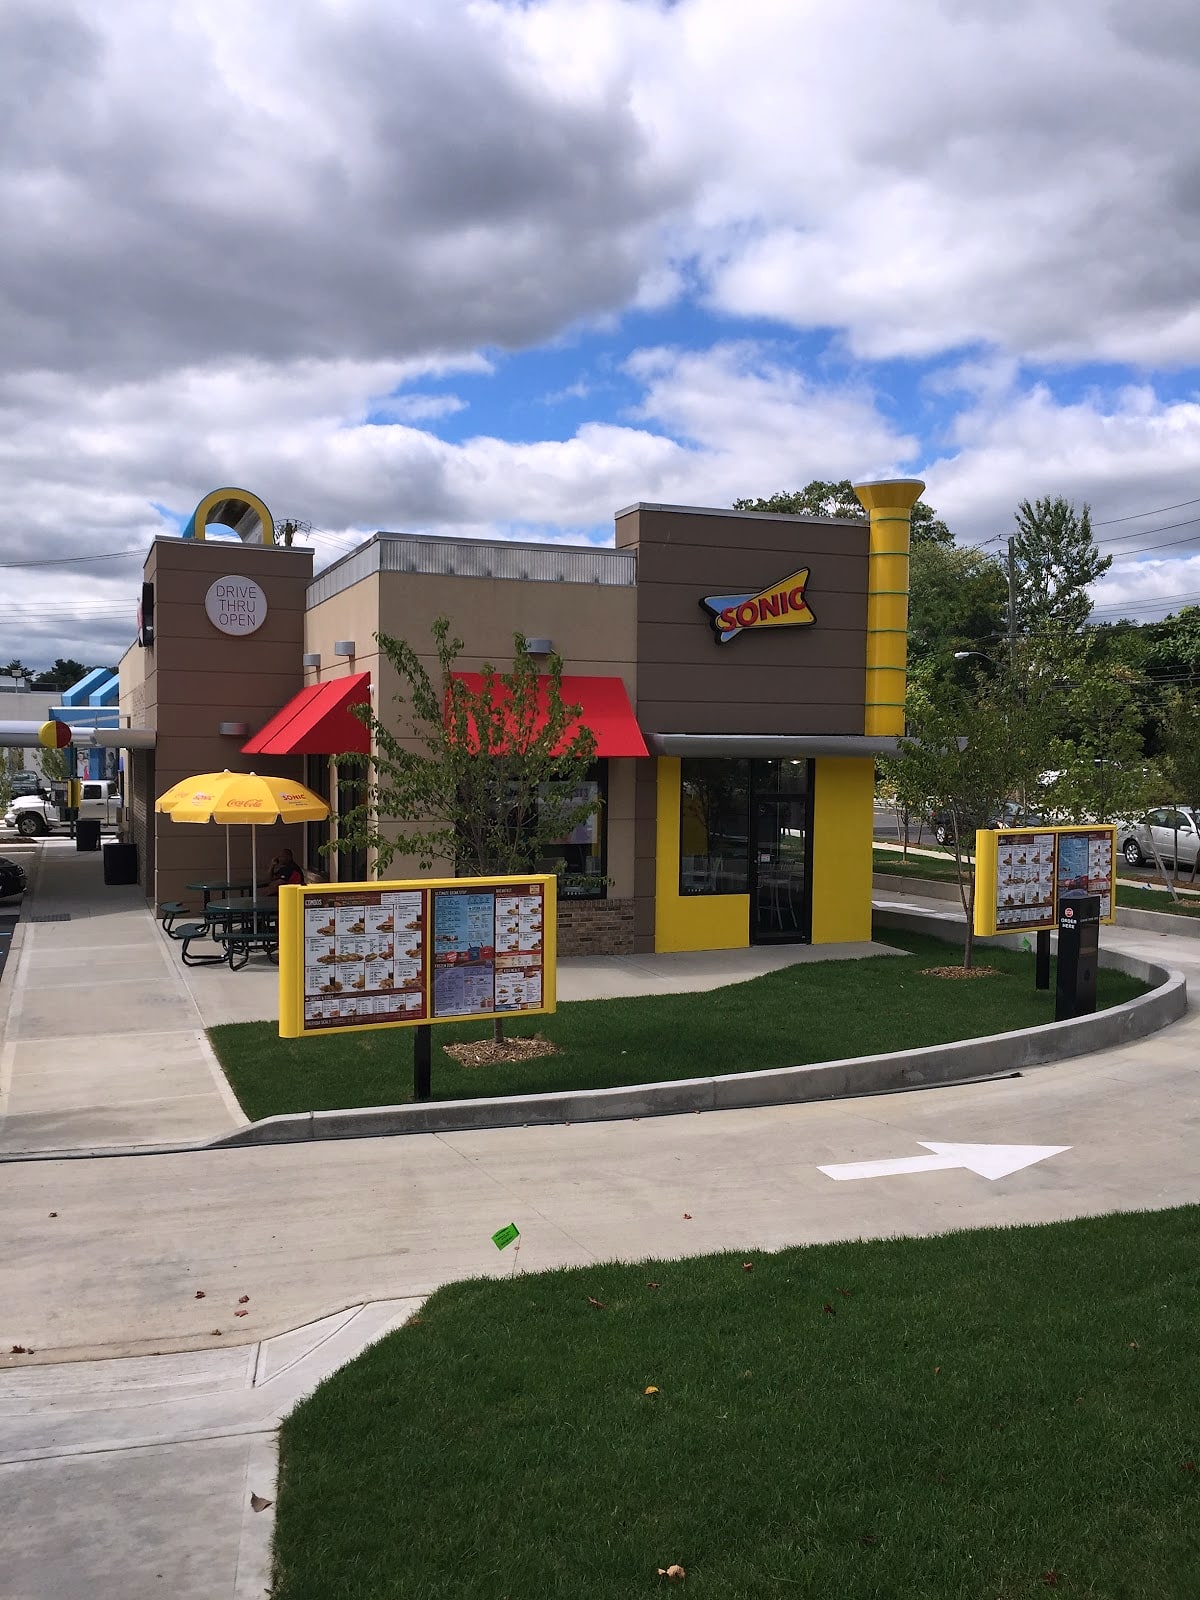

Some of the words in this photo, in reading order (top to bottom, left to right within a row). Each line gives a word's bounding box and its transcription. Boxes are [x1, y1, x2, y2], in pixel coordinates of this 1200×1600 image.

[216, 585, 256, 598] DRIVE
[219, 599, 255, 612] THRU
[719, 586, 807, 633] SONIC
[219, 613, 255, 626] OPEN
[227, 798, 263, 808] Coca-Cola
[282, 793, 306, 801] SONIC
[1060, 917, 1077, 925] ORDER
